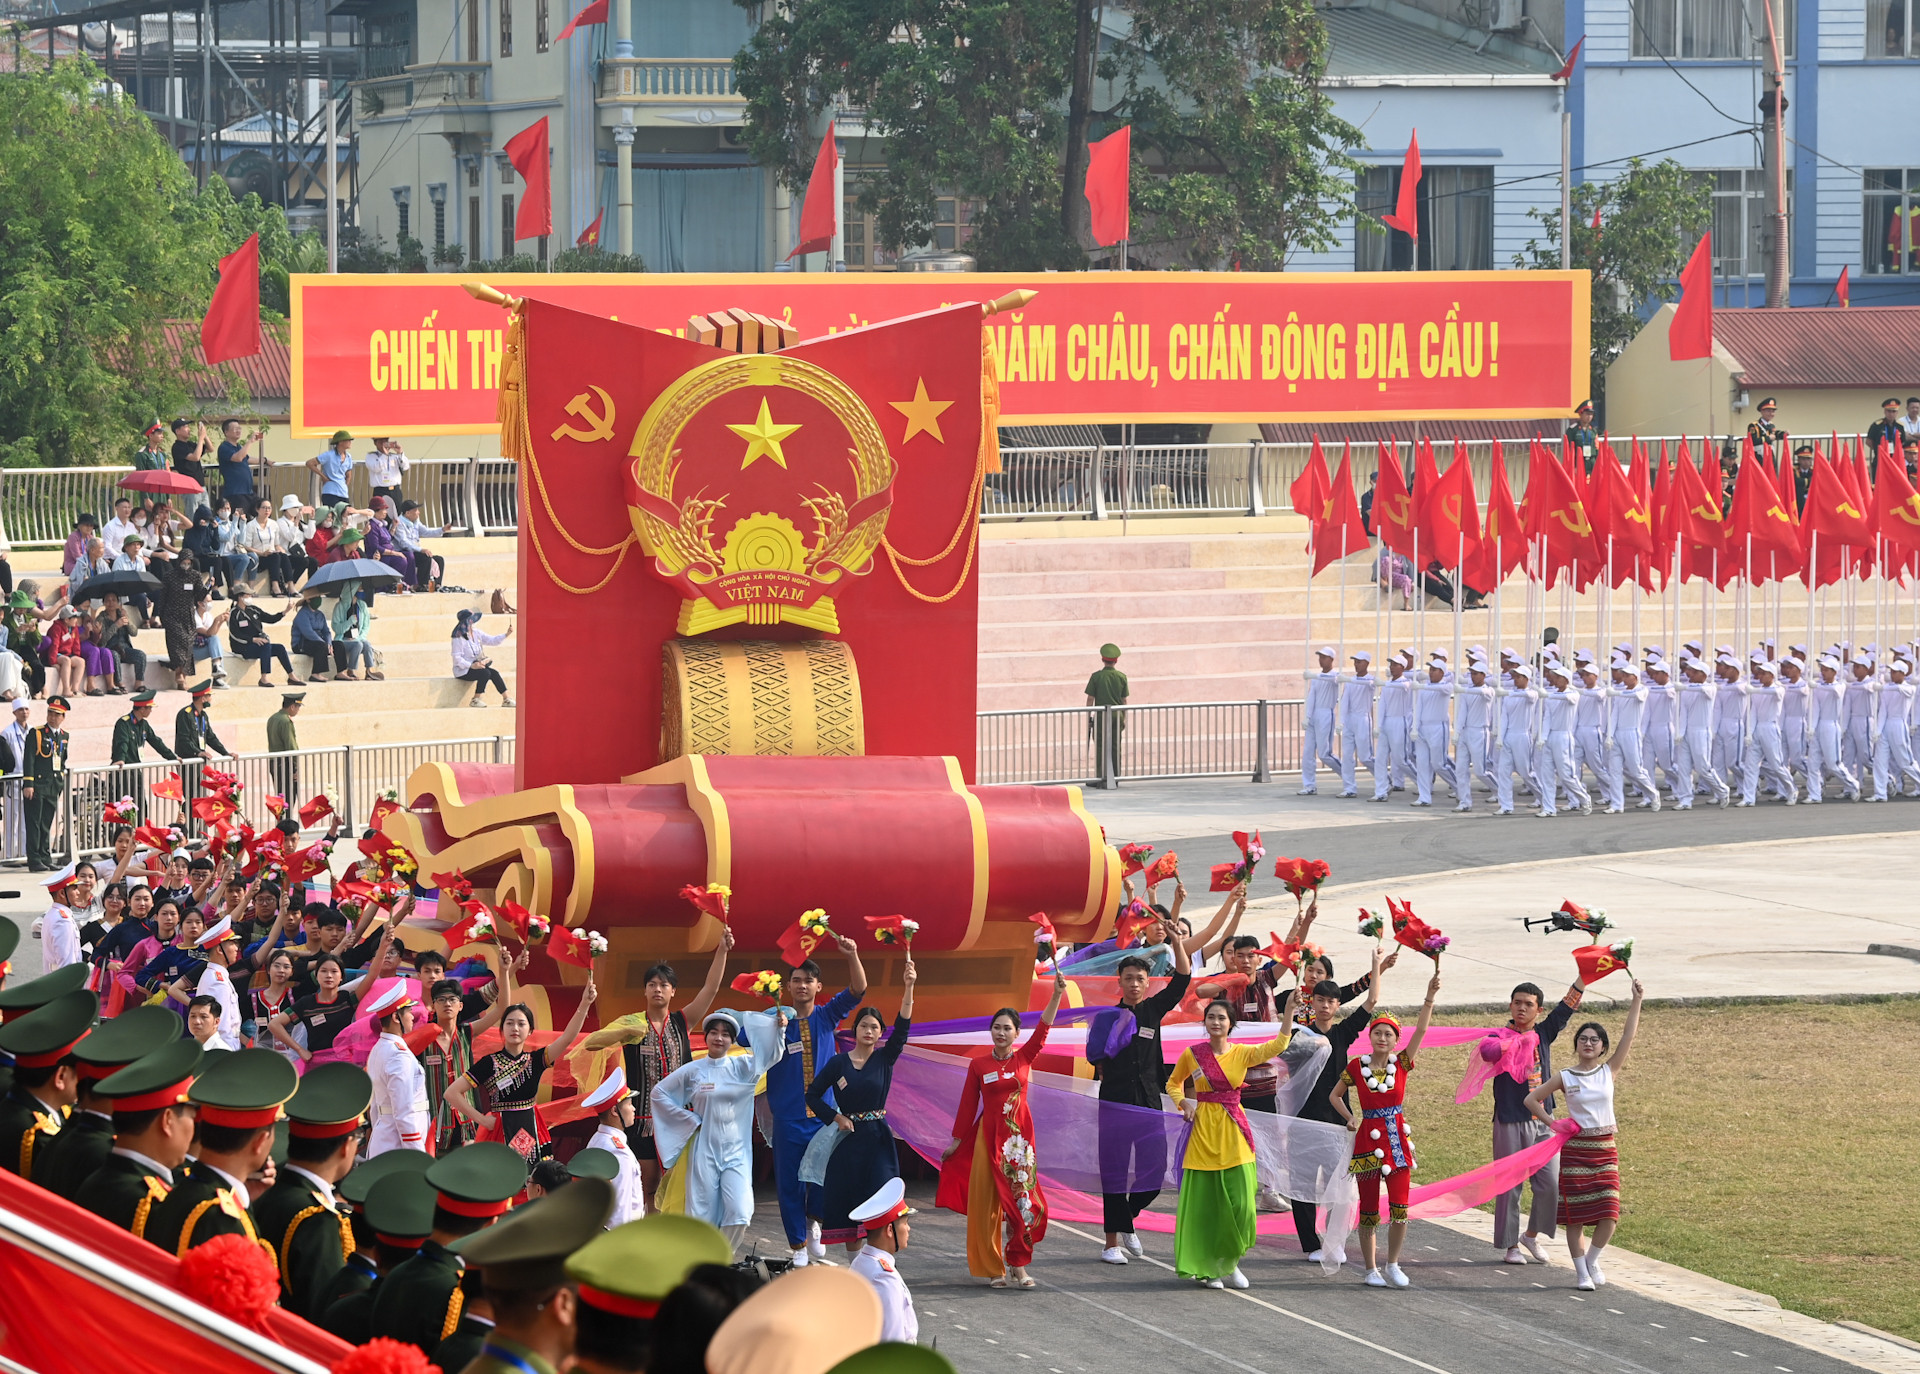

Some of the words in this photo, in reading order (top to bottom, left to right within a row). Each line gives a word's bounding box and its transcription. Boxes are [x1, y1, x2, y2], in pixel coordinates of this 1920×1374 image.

[370, 310, 458, 391] CHIẾN
[985, 312, 1056, 382] NĂM
[1067, 311, 1158, 388] CHÂU,
[1168, 303, 1251, 381] CHẤN
[1260, 311, 1346, 393] ĐỘNG
[1355, 323, 1409, 392] ĐỊA
[725, 582, 763, 602] VIỆT
[766, 585, 805, 602] NAM
